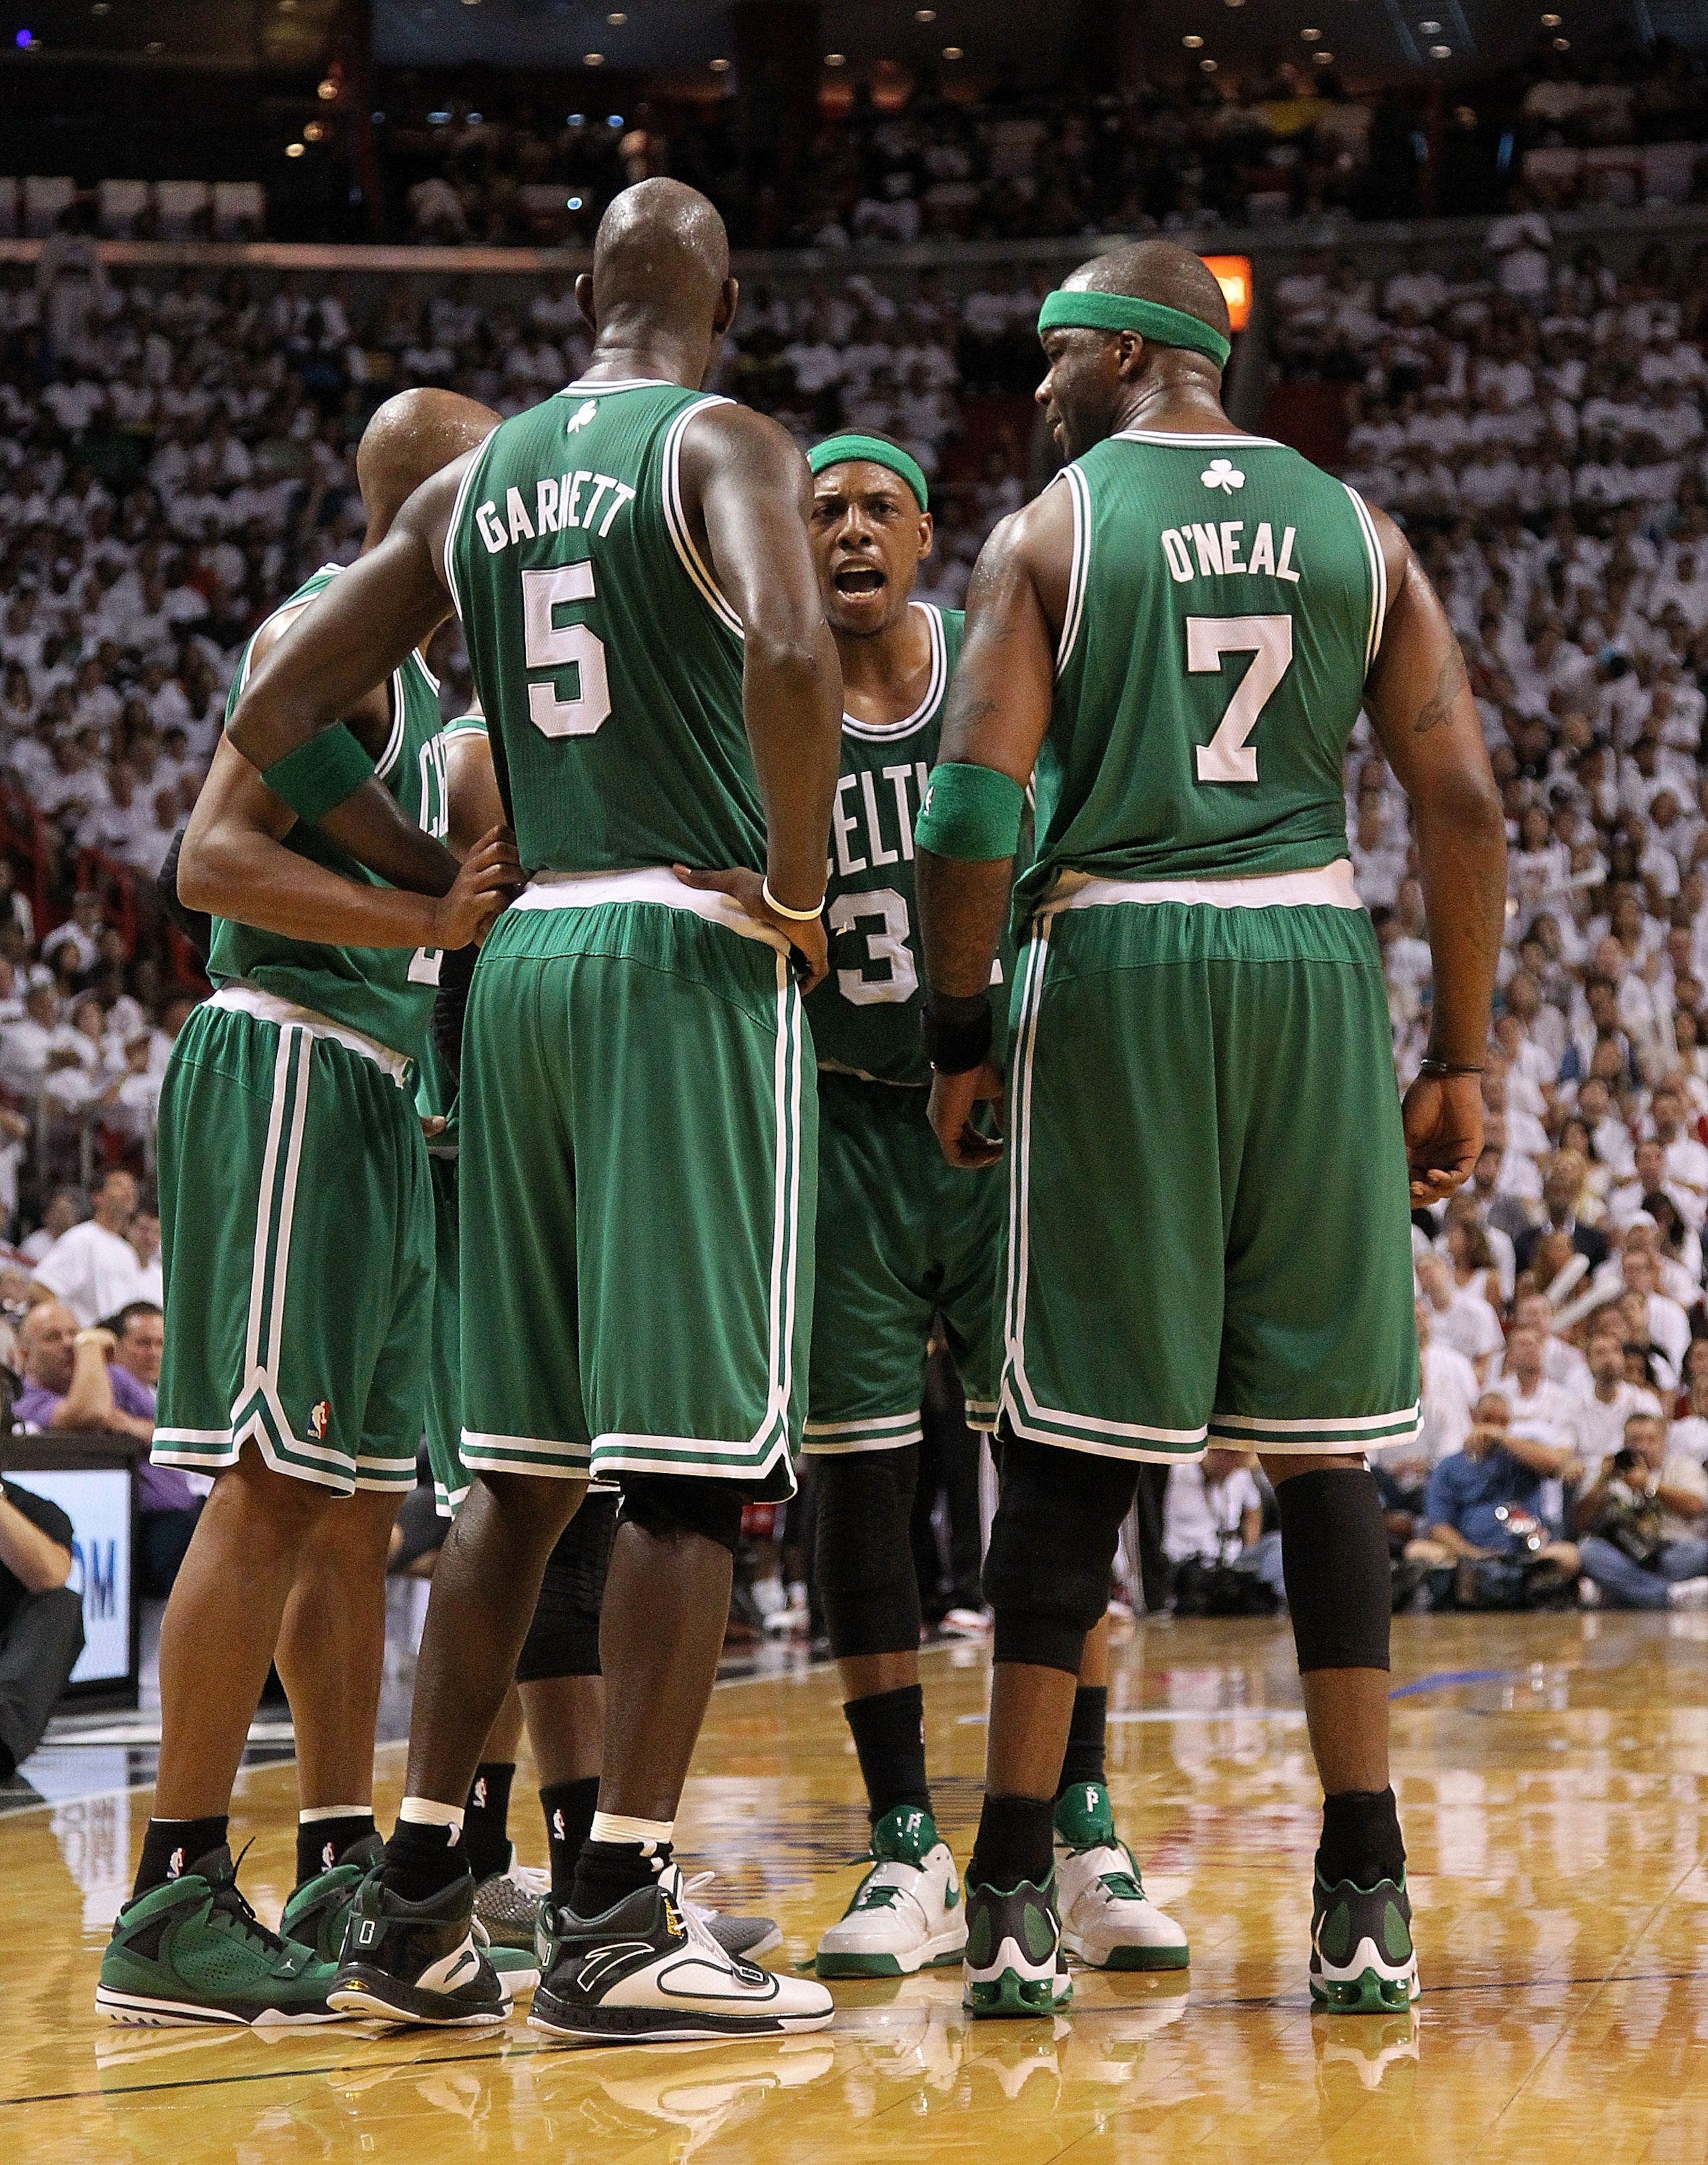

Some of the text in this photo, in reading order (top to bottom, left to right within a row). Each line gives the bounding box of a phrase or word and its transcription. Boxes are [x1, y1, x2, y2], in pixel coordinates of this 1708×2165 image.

[475, 470, 636, 554] GARNETT
[1161, 520, 1300, 583] O'NEAL
[521, 560, 612, 739] 5
[1186, 614, 1293, 782] 7
